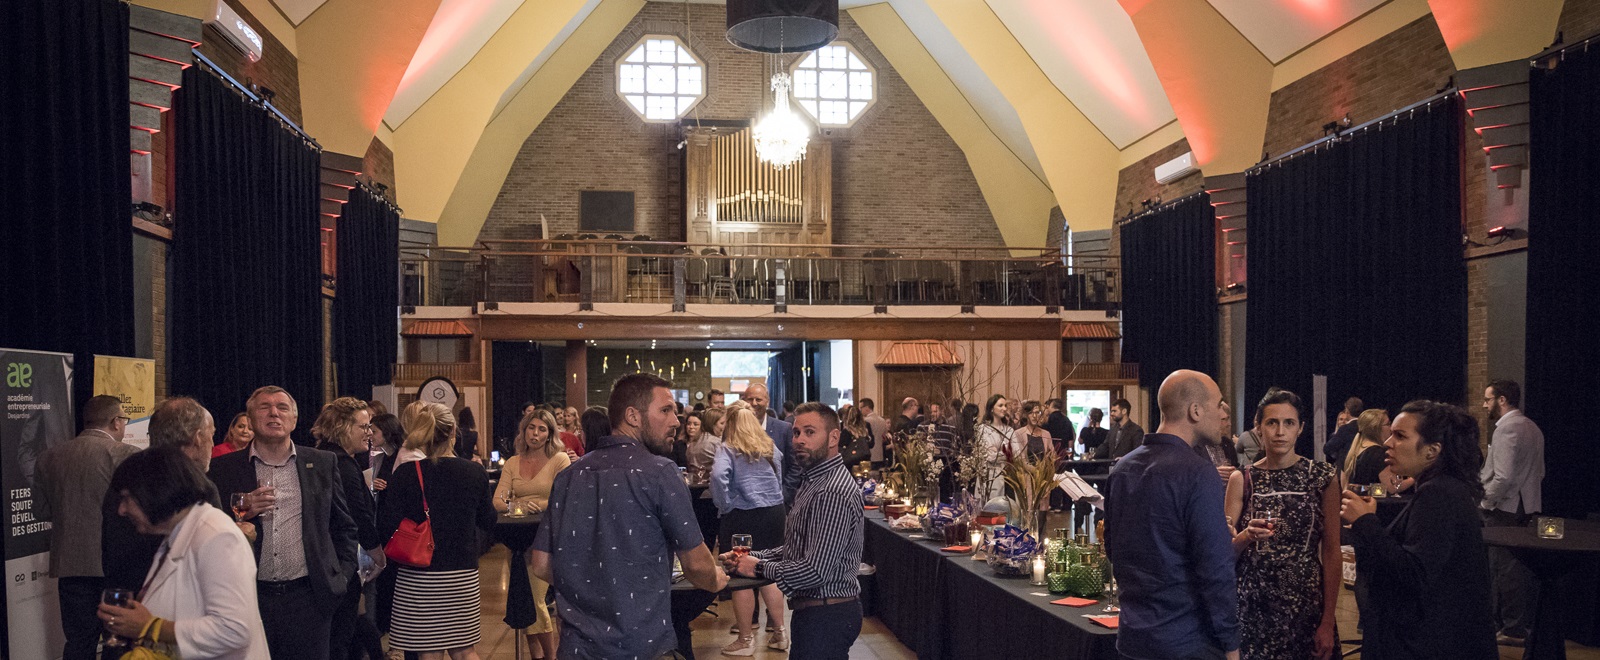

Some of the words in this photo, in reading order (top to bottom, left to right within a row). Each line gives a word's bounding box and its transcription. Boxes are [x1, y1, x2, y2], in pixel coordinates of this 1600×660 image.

[7, 394, 34, 402] académie
[7, 402, 51, 411] entrepreneuriale
[10, 487, 31, 500] FIERS
[12, 525, 26, 537] DES
